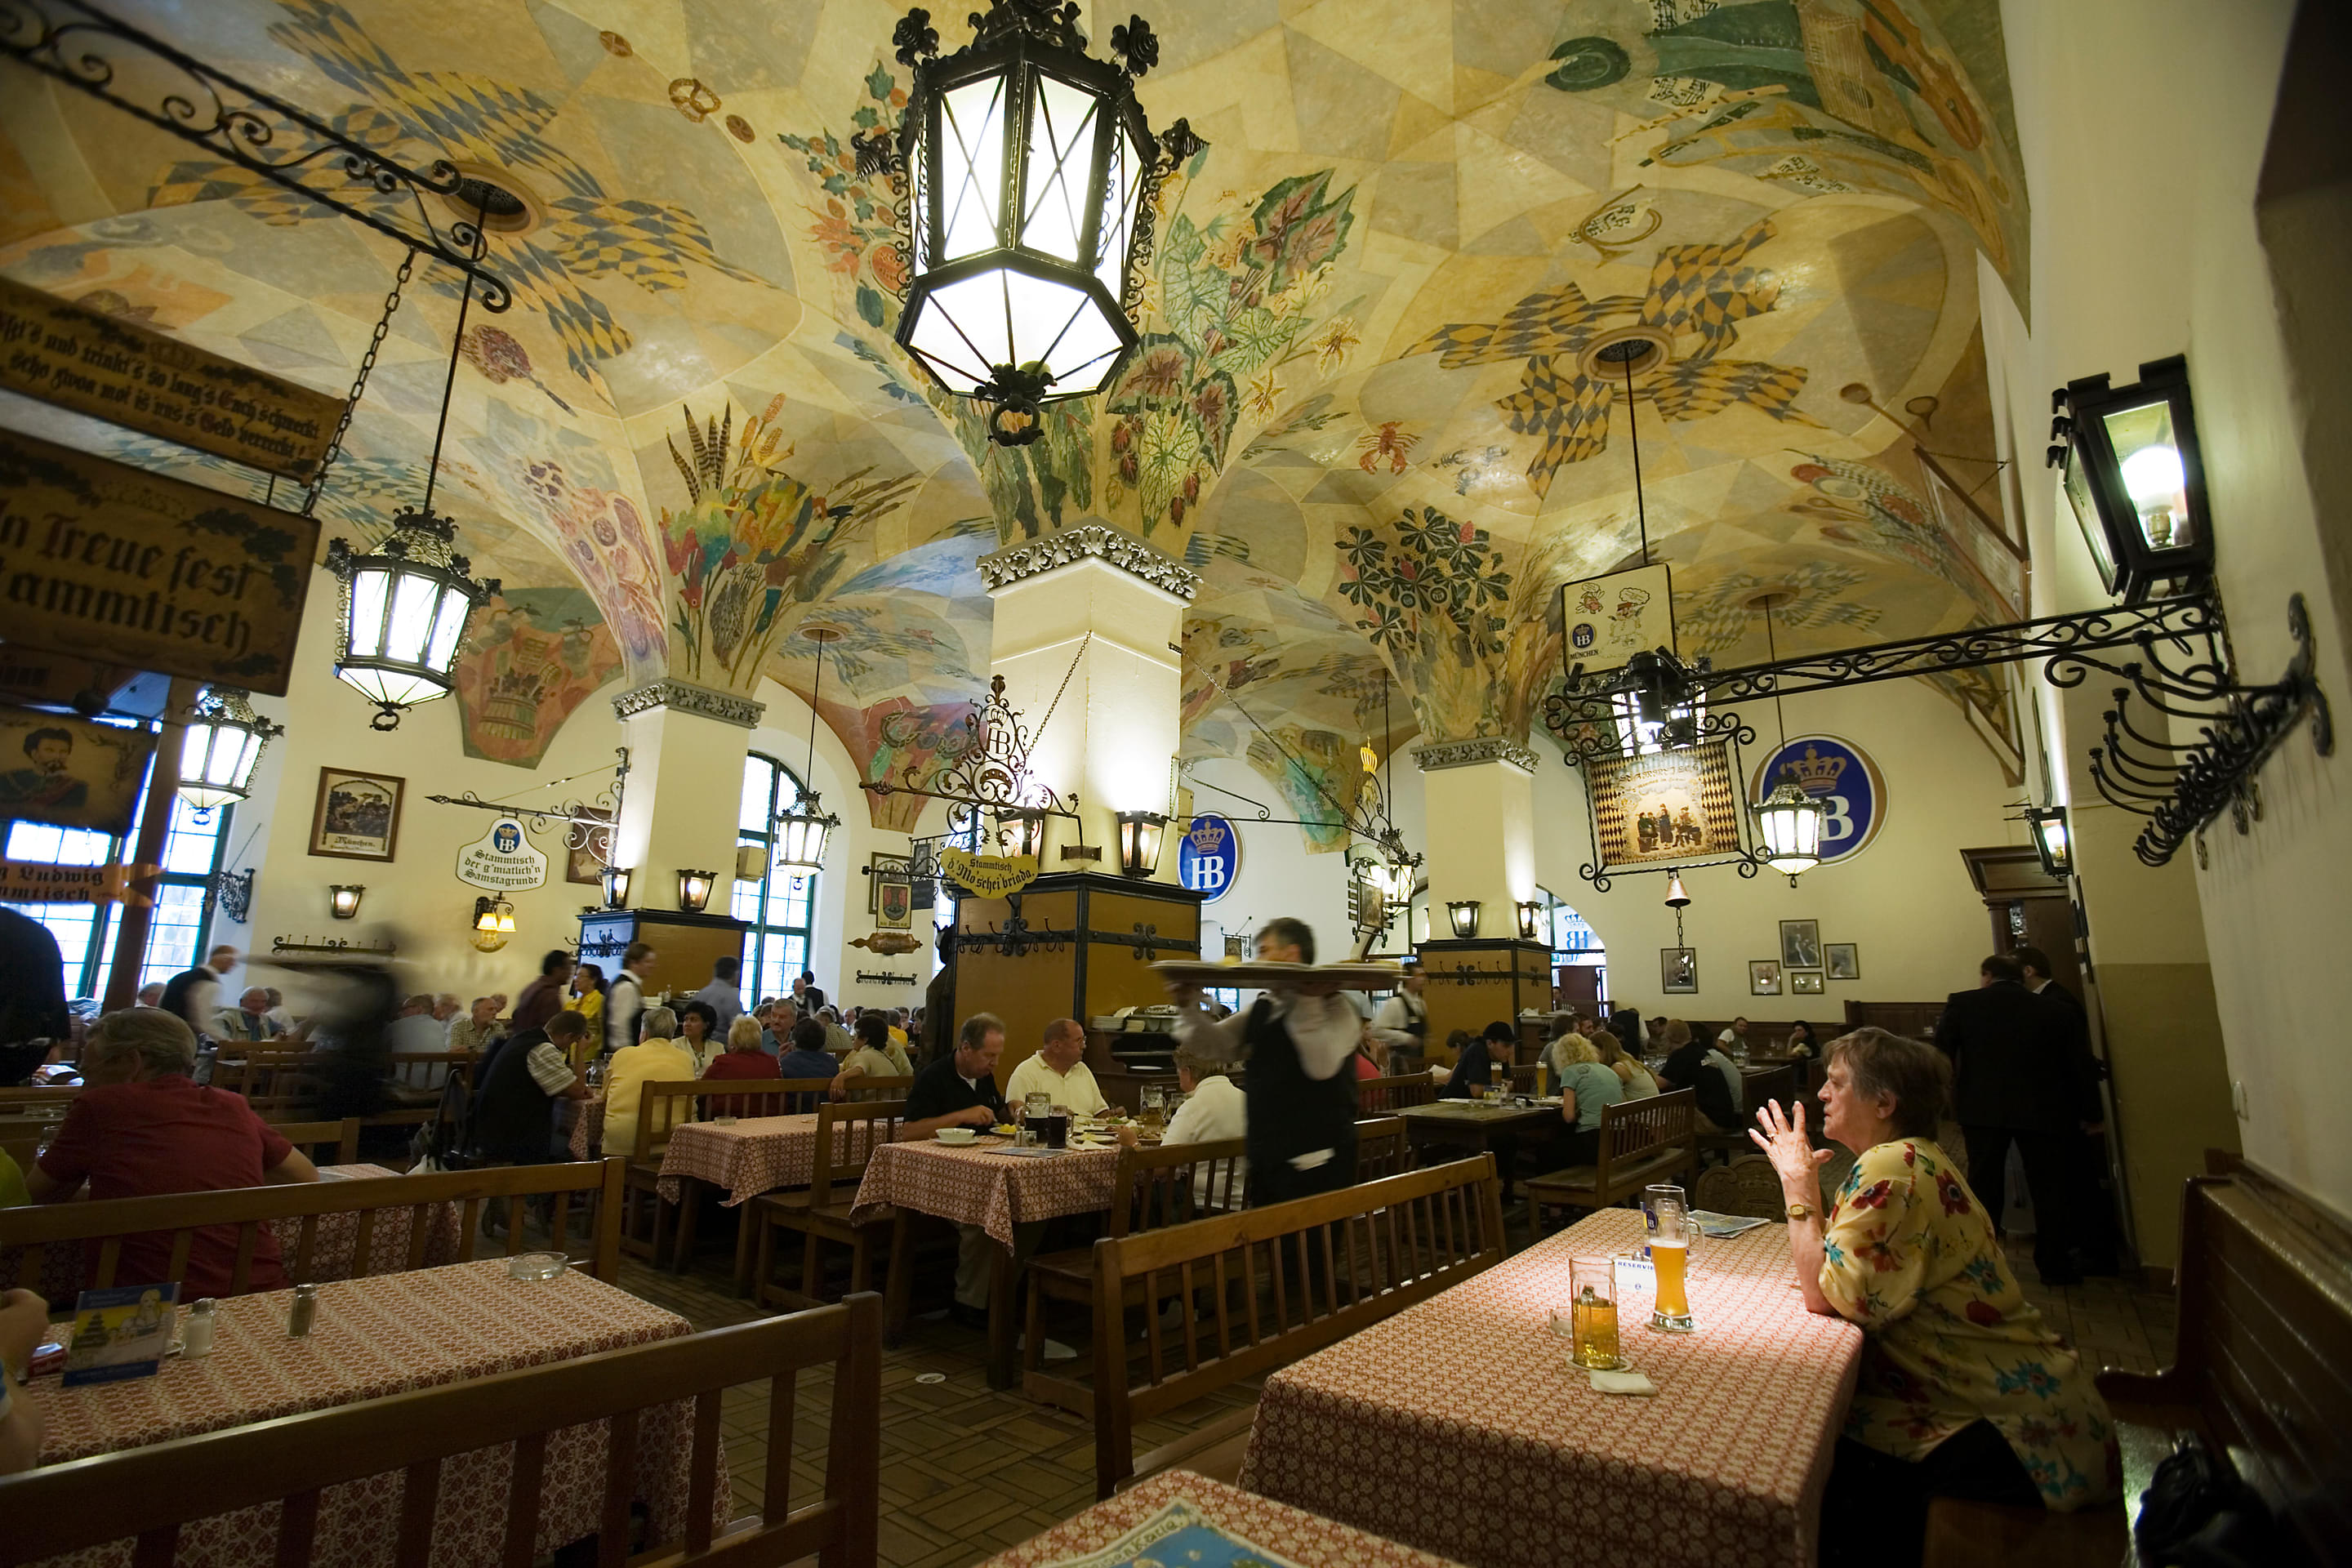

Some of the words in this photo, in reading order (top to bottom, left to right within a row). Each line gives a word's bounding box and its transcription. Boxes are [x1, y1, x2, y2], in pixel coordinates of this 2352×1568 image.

[0, 499, 30, 550] n
[37, 512, 164, 579] Treue
[167, 545, 252, 600] fest
[0, 557, 251, 661] ammtisch
[1576, 634, 1591, 647] HB
[1570, 649, 1599, 661] MÜNCHEN
[1819, 795, 1855, 842] B
[499, 839, 516, 852] HB
[464, 857, 480, 869] der
[474, 849, 535, 865] Stammtisch
[969, 858, 1013, 874] Stammtisch
[1190, 855, 1225, 890] HB
[19, 866, 105, 887] Ludwig
[464, 868, 538, 887] Samstagrunde
